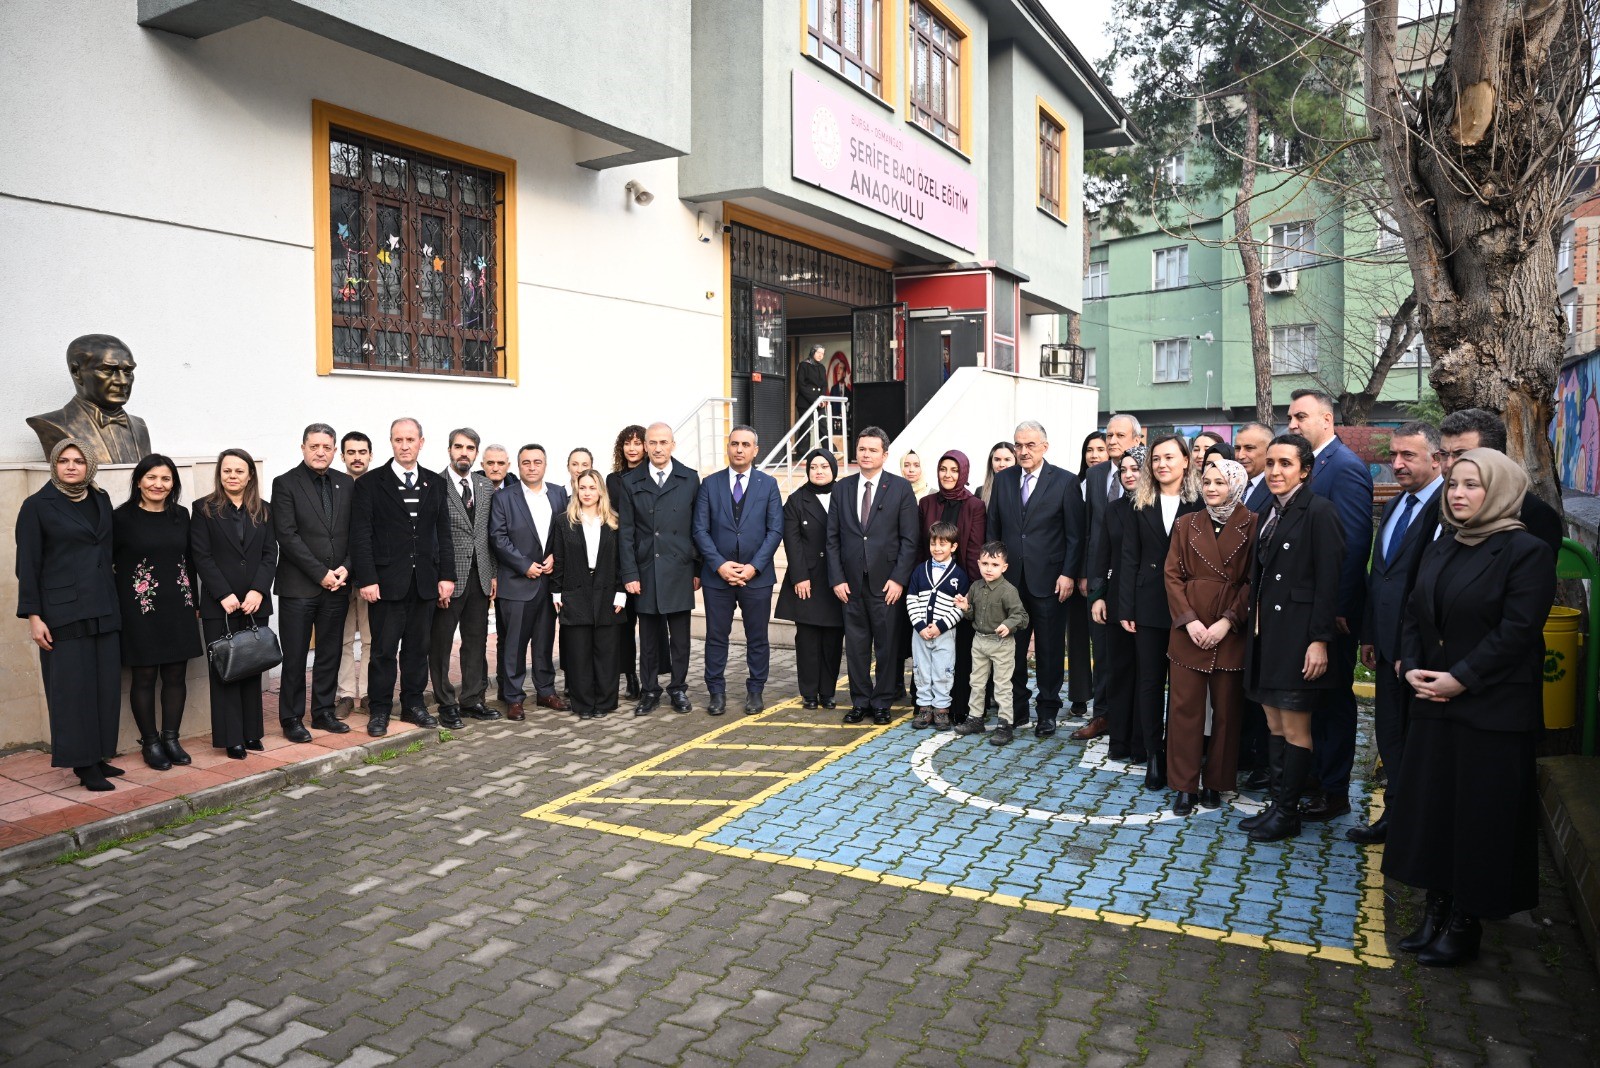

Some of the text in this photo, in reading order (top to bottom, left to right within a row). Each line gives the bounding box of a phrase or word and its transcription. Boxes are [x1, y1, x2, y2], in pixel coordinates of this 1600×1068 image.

[851, 114, 870, 133] BURSA
[850, 137, 968, 214] ŞERİFE BACI ÖZEL EĞİTİM
[850, 170, 924, 221] ANAOKULU
